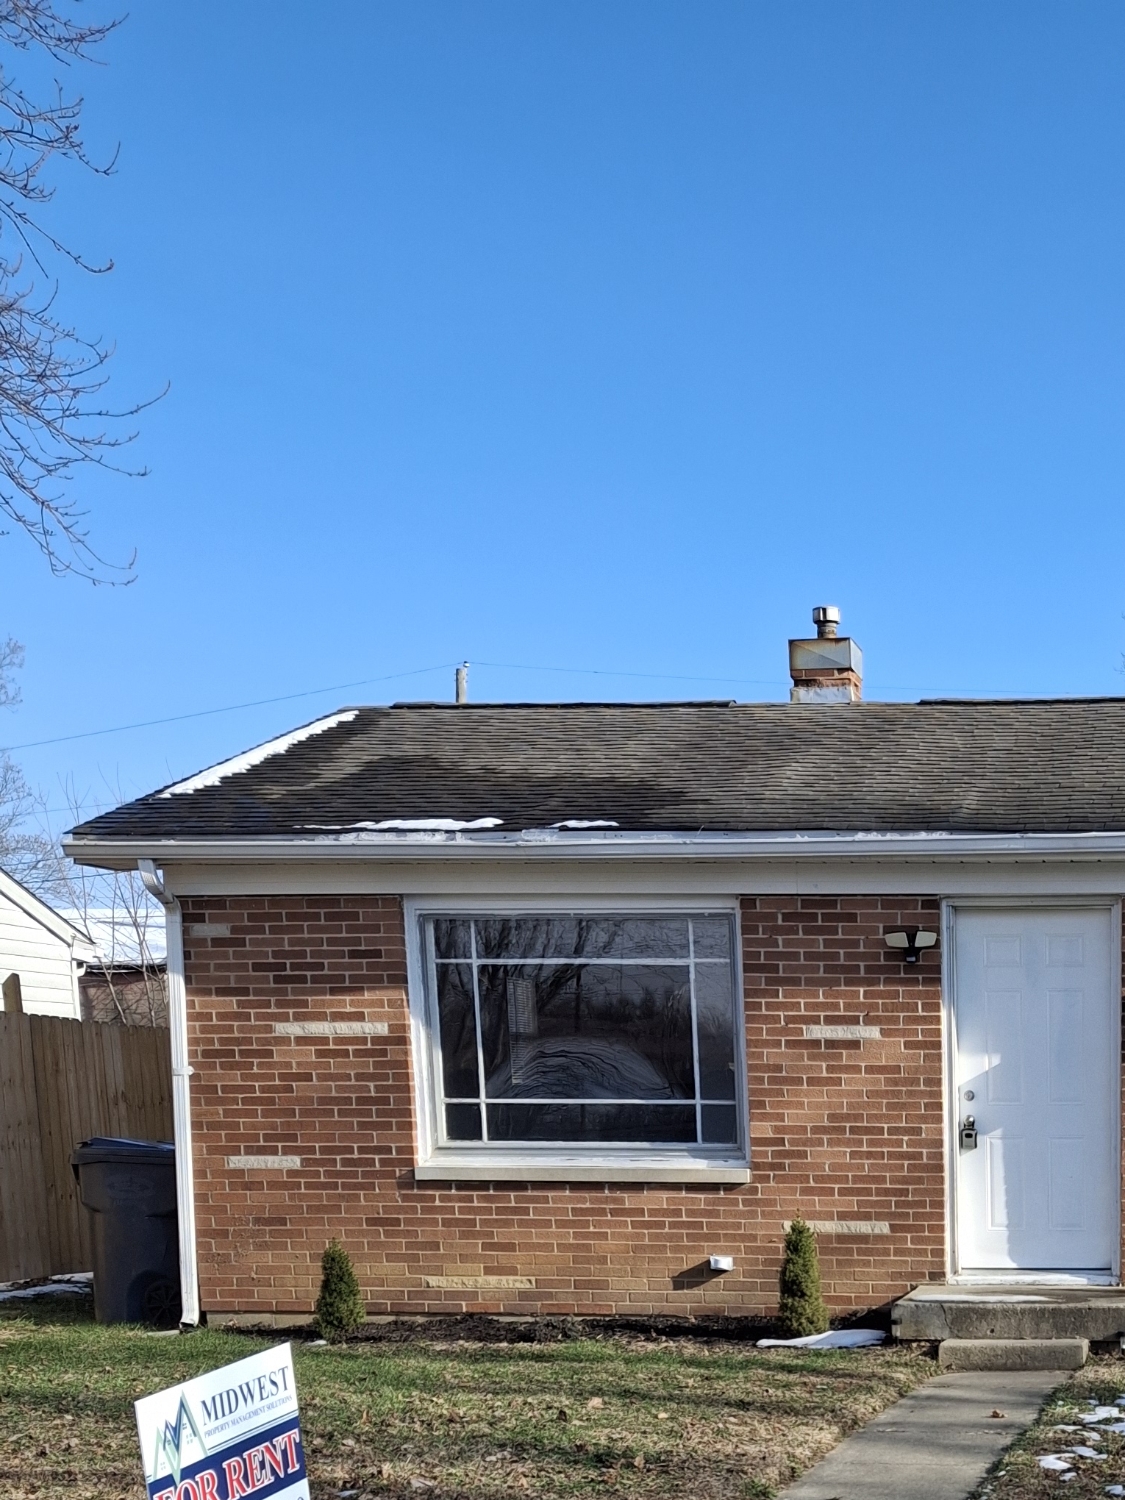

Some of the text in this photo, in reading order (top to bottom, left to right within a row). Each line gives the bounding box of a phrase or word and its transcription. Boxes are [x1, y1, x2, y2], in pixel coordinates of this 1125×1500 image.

[200, 1366, 289, 1426] MIDWEST
[204, 1394, 293, 1438] PROPERTY MANAGEMENT SOLUTIONS
